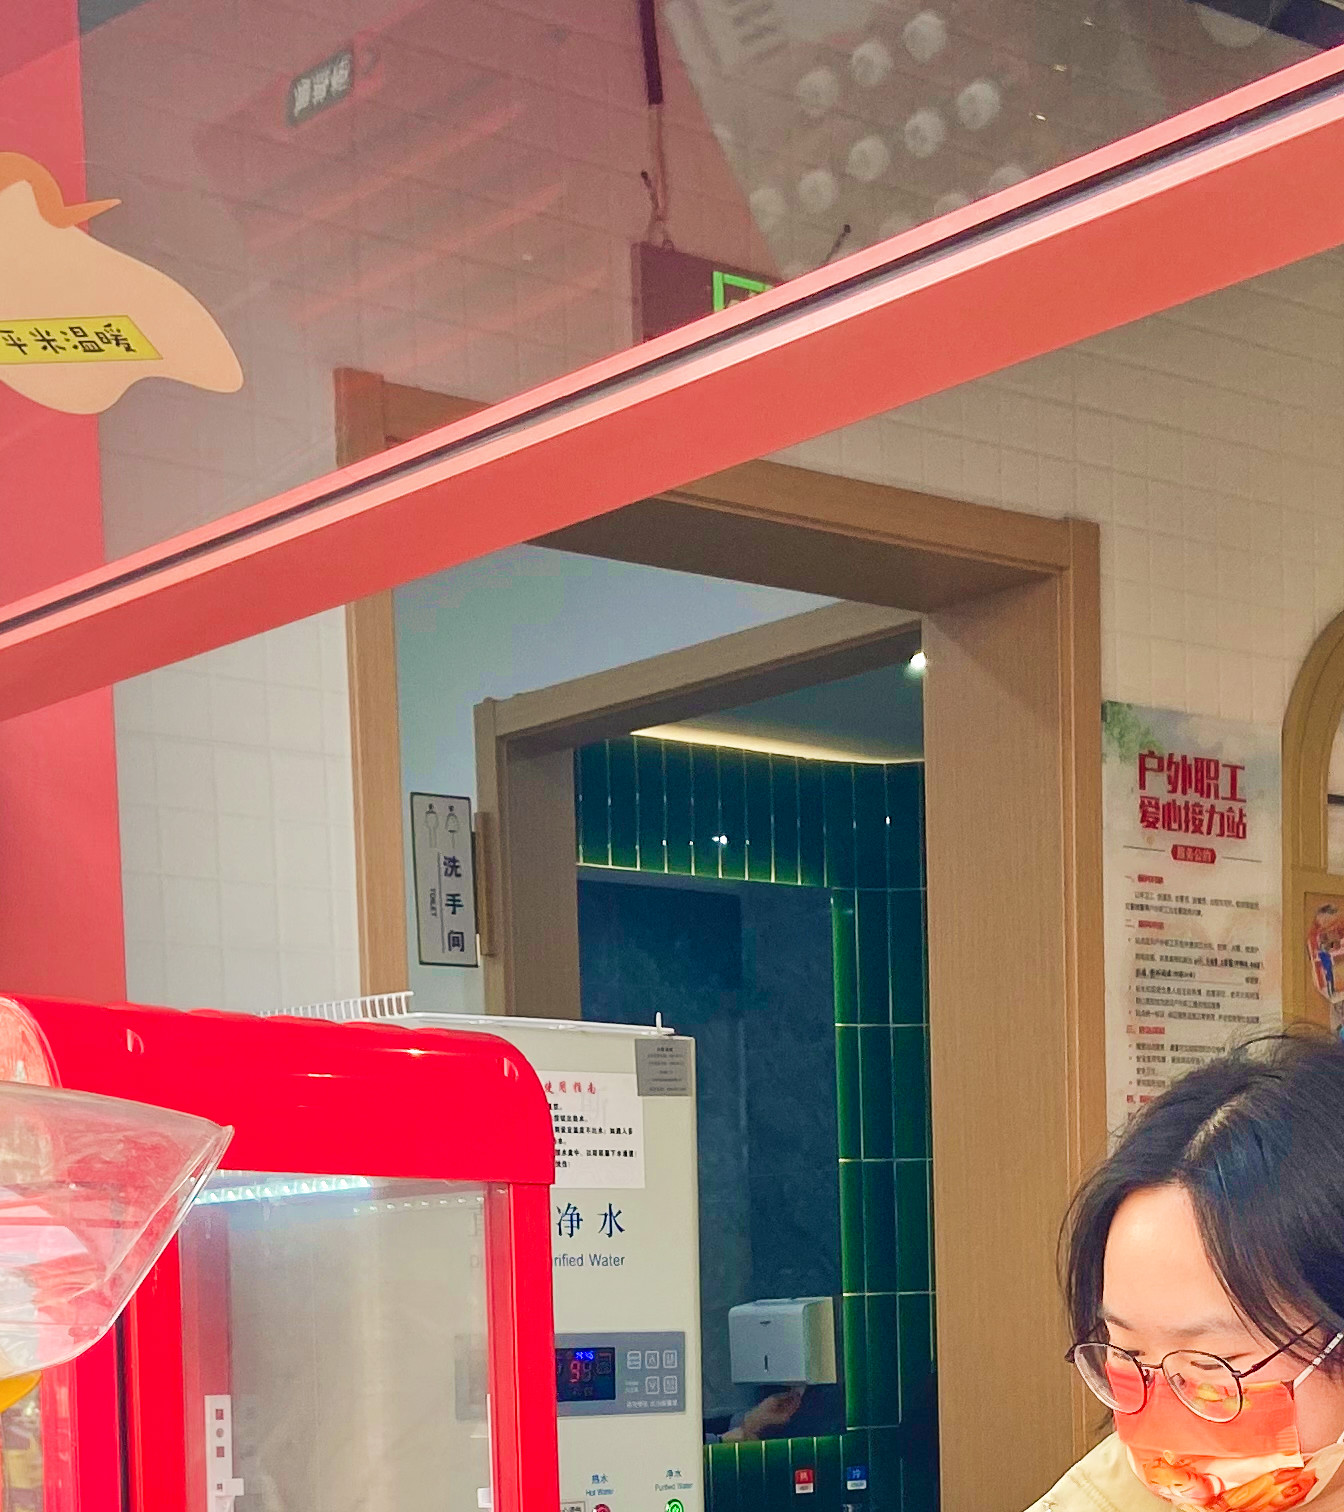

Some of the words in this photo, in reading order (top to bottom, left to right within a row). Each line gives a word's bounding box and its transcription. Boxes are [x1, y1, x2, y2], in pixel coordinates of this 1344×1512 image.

[1138, 750, 1246, 803] 户外职工
[1139, 796, 1247, 840] 爱心接力站
[443, 856, 465, 952] 洗手间
[556, 1203, 625, 1238] 净水
[554, 1254, 584, 1266] rified
[589, 1254, 625, 1266] Water
